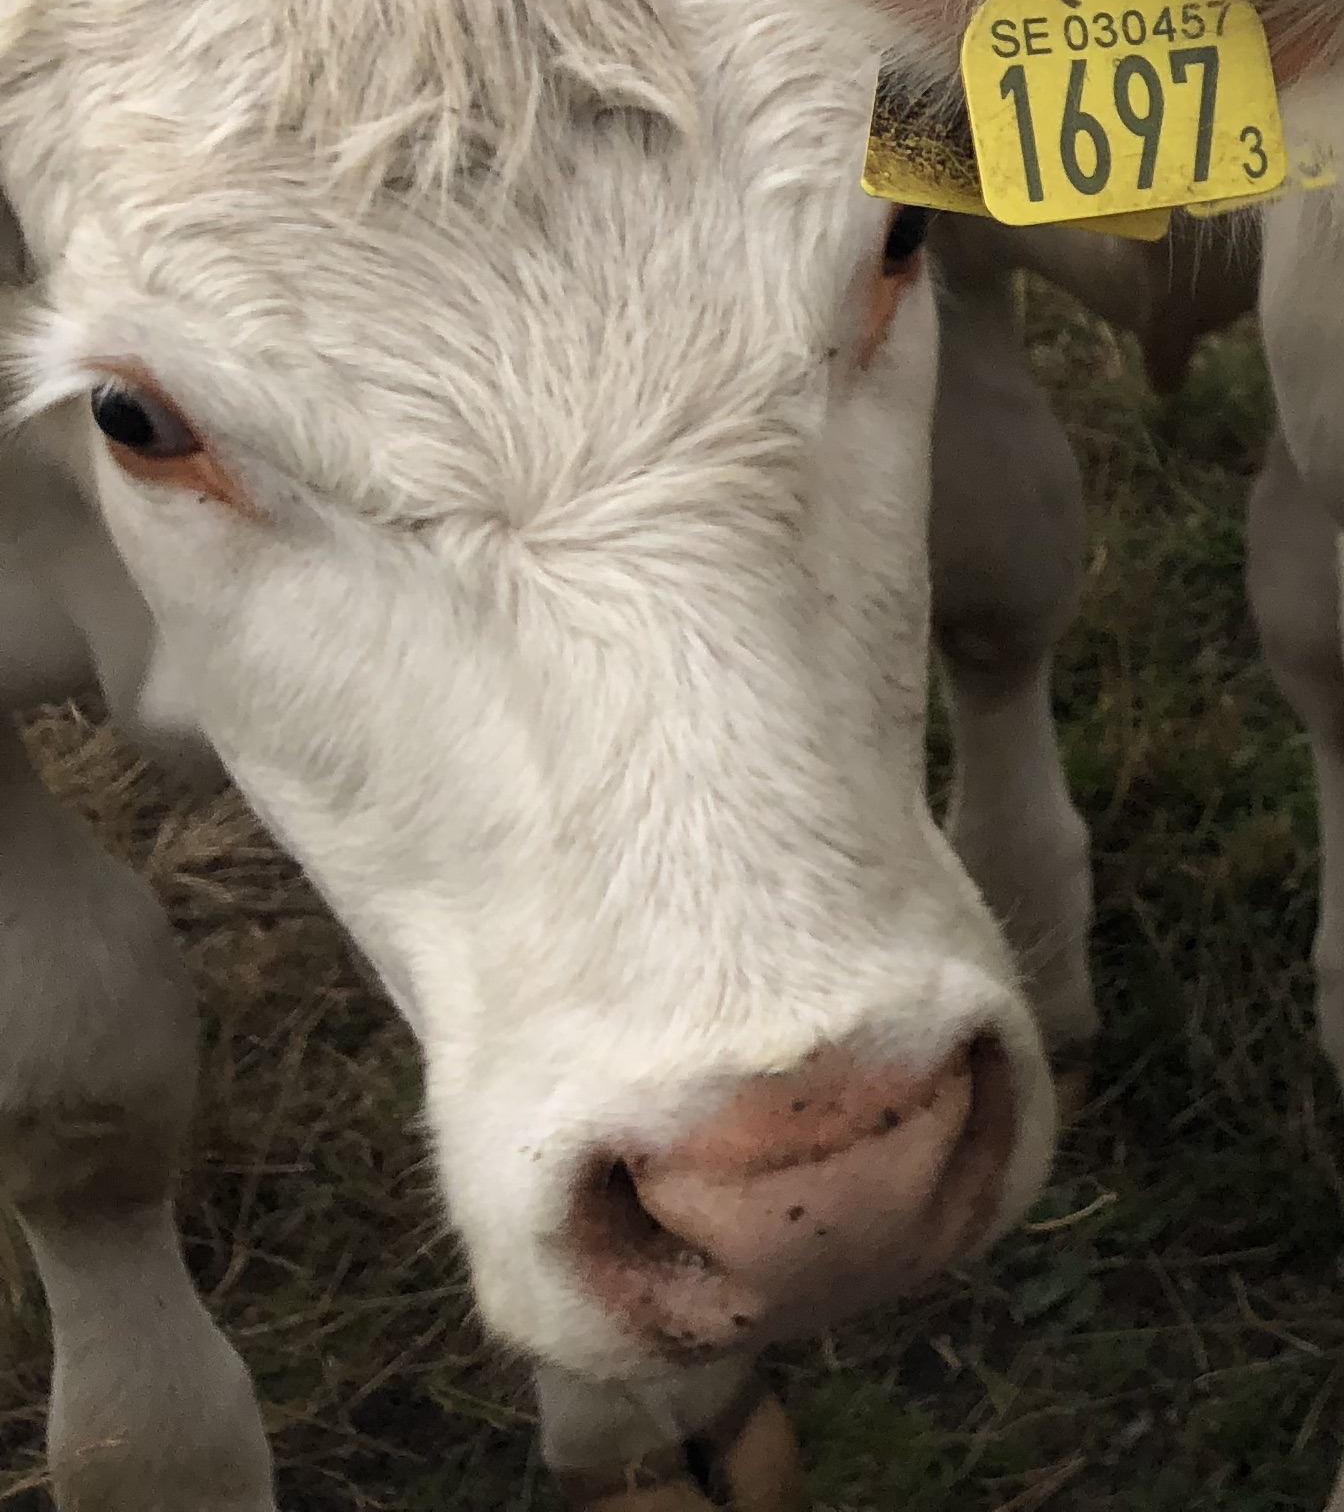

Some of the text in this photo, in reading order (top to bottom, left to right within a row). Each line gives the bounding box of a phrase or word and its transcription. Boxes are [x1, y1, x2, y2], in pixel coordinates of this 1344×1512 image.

[991, 0, 1231, 58] SE 030457
[1000, 45, 1268, 202] 1697 3
